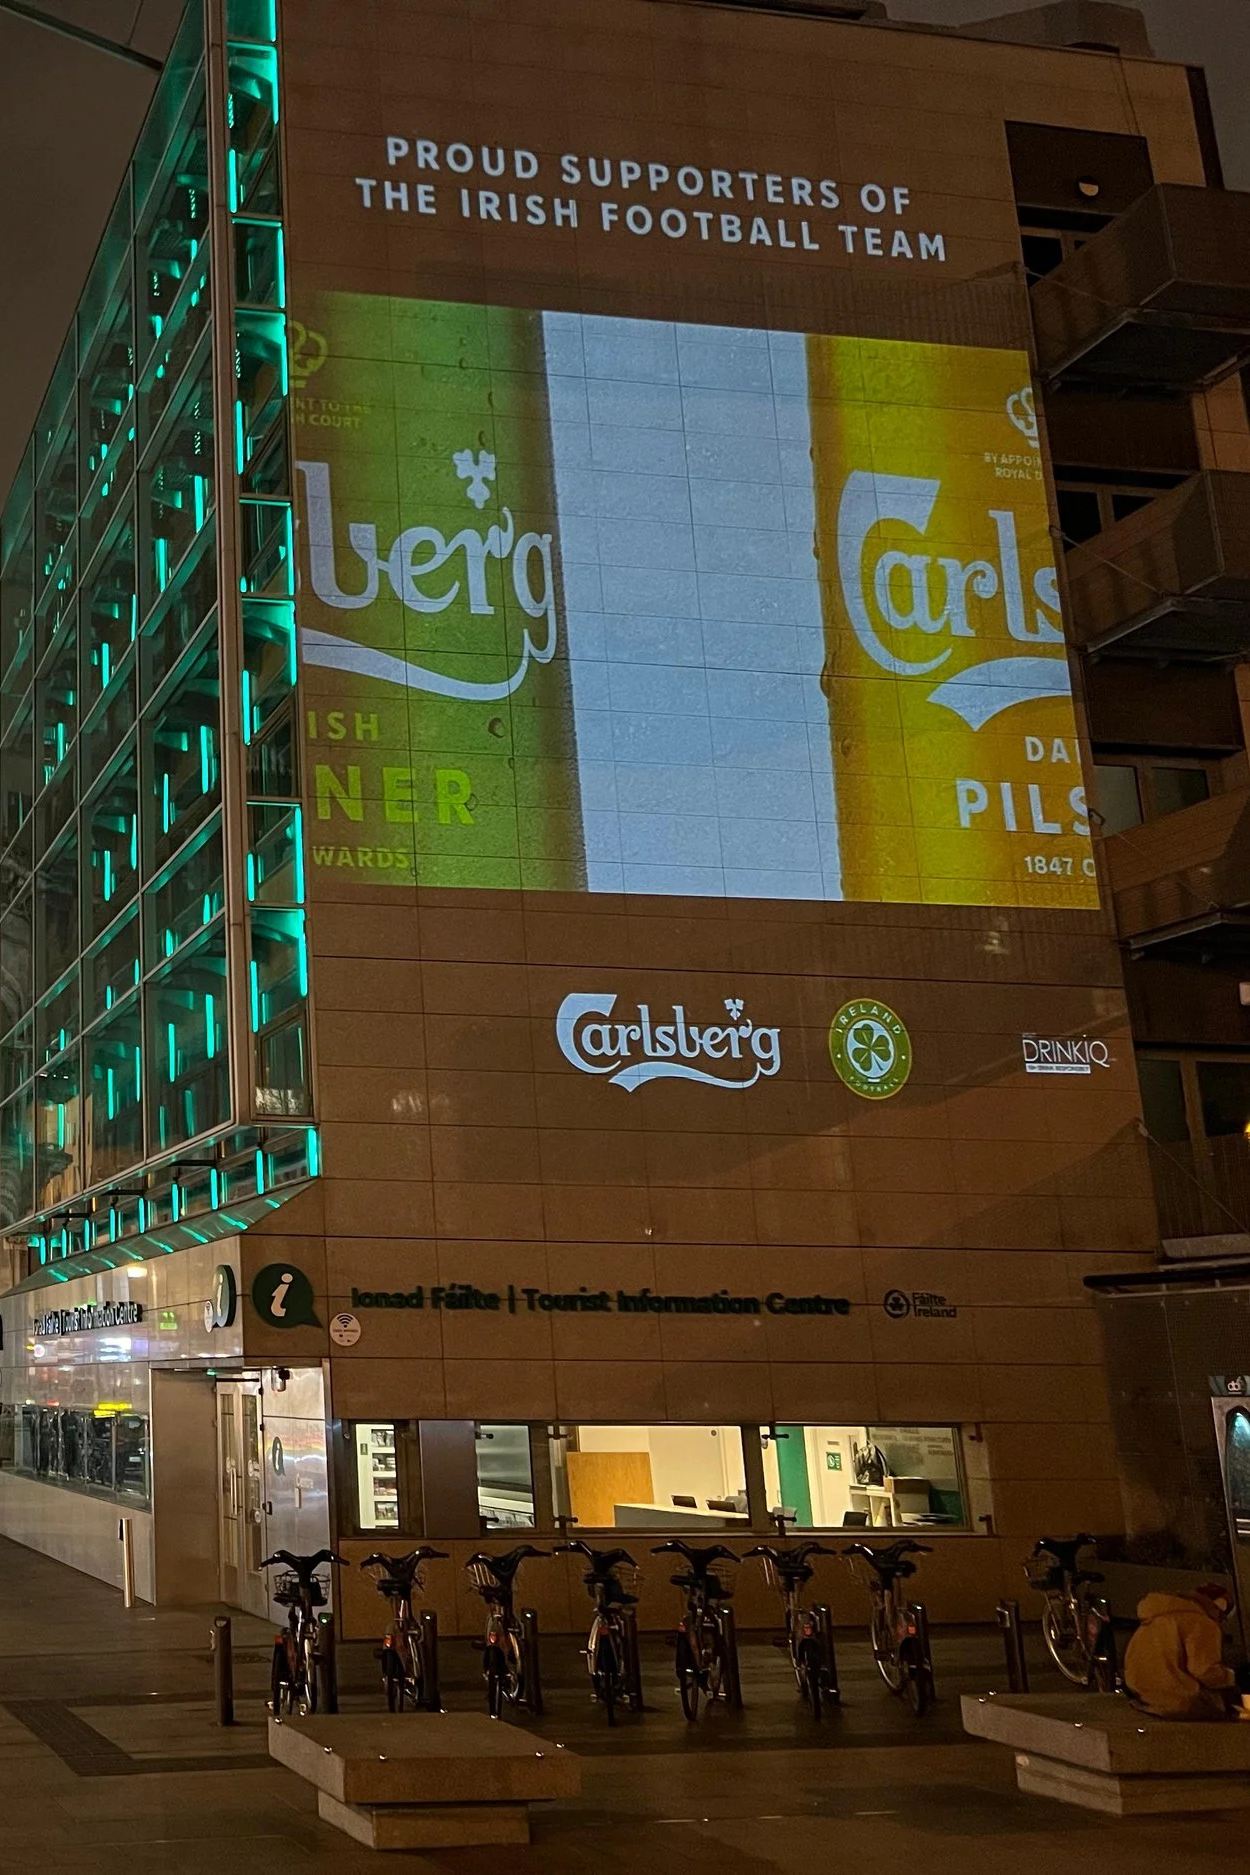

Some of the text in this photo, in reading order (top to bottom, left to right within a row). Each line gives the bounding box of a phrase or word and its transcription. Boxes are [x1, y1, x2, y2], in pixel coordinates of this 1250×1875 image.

[387, 137, 910, 215] PROUD SUPPORTERS OF
[355, 177, 946, 262] THE IRISH FOOTBALL TEAM
[310, 414, 361, 429] COURT
[984, 452, 997, 464] BY
[995, 467, 1032, 480] ROYAL
[308, 711, 380, 742] ISH
[1025, 736, 1081, 764] DA
[315, 764, 474, 825] NER
[956, 778, 1091, 836] PILS
[311, 845, 410, 870] WARDS
[1024, 855, 1073, 875] 1847
[835, 1003, 902, 1035] IRELAND
[556, 993, 781, 1076] Carlsberg
[521, 1286, 611, 1313] Tourist
[617, 1287, 761, 1315] Information
[766, 1292, 849, 1315] Centre
[913, 1306, 958, 1318] Ireland
